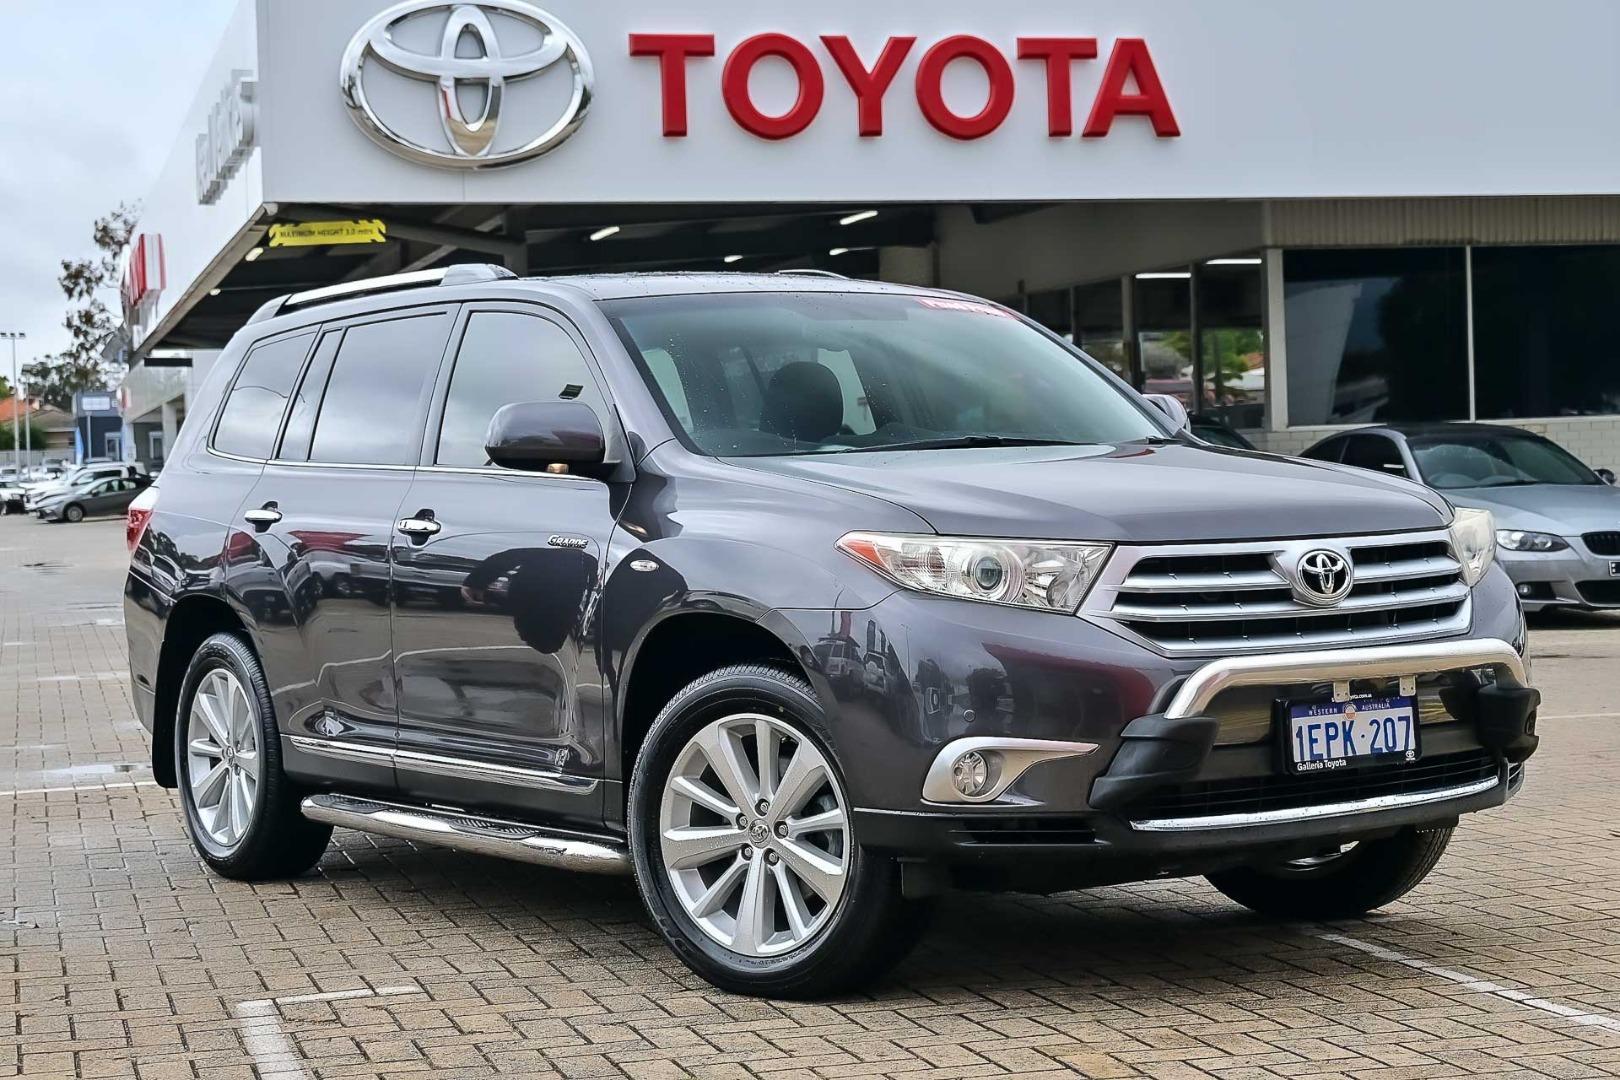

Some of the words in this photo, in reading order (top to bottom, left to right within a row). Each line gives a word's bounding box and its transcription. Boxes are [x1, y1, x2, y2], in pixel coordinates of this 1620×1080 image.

[629, 33, 1180, 140] TOYOTA
[1308, 707, 1338, 716] WESTERN
[1361, 702, 1391, 711] AUSTRALIA
[1297, 760, 1324, 772] Galleria
[1325, 759, 1347, 770] Toyota
